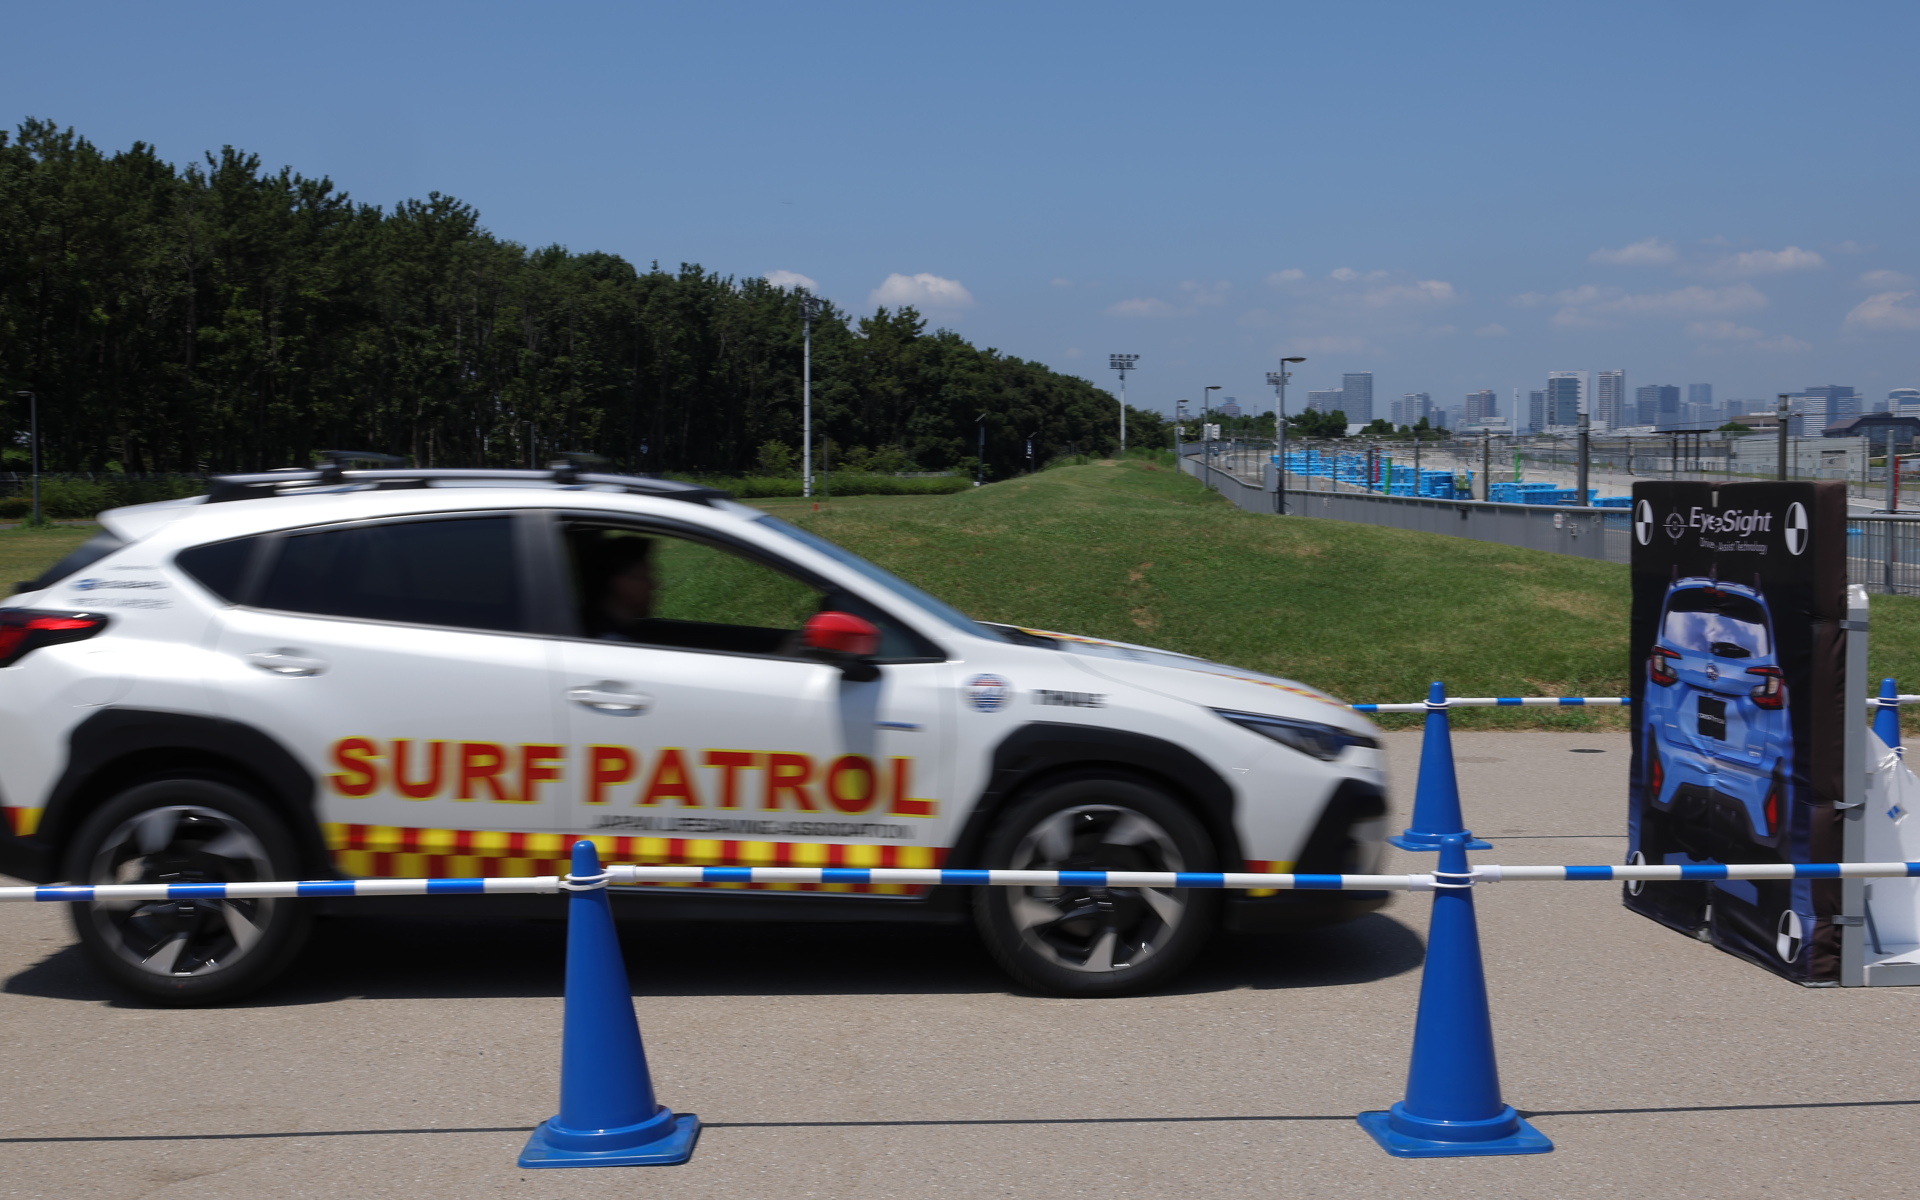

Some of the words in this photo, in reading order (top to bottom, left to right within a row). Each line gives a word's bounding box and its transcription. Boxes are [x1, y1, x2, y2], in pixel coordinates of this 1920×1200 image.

[1689, 506, 1773, 537] EyeSight
[321, 735, 569, 804] SURF
[580, 743, 941, 819] PATROL
